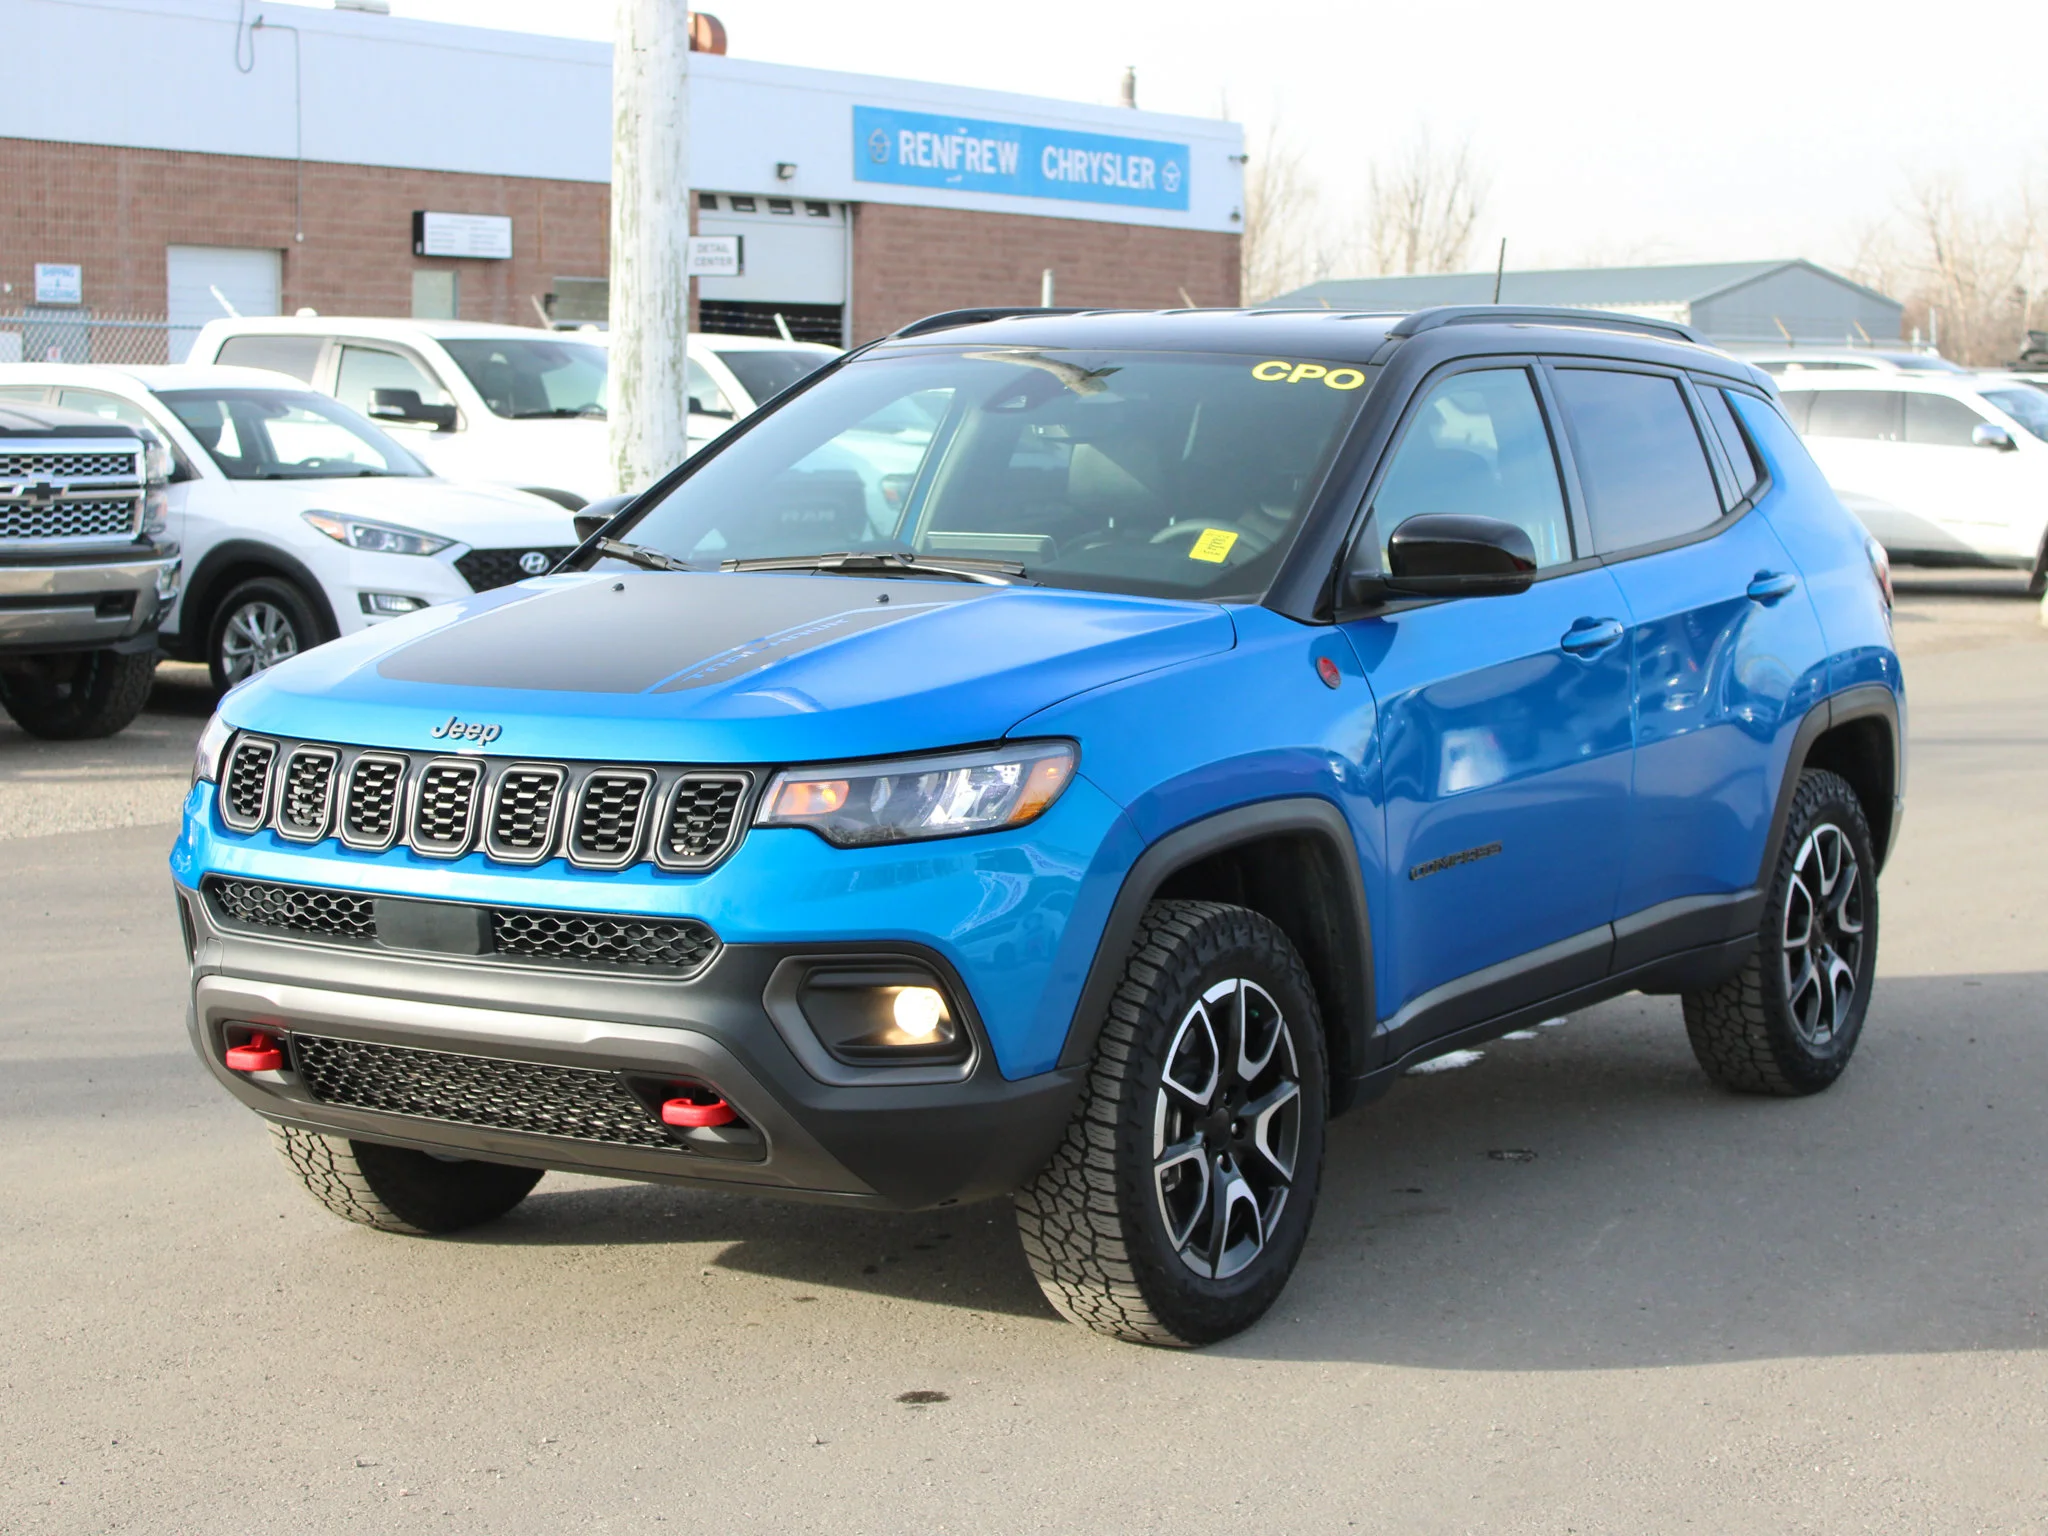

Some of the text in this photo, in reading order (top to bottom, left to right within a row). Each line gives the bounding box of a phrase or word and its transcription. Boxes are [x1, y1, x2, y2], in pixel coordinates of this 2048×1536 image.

[898, 130, 1156, 190] RENFREW CHRYSLER
[694, 256, 733, 267] CENTER
[696, 243, 730, 253] DETAIL
[1251, 360, 1366, 390] CPO
[430, 715, 503, 748] Jeep
